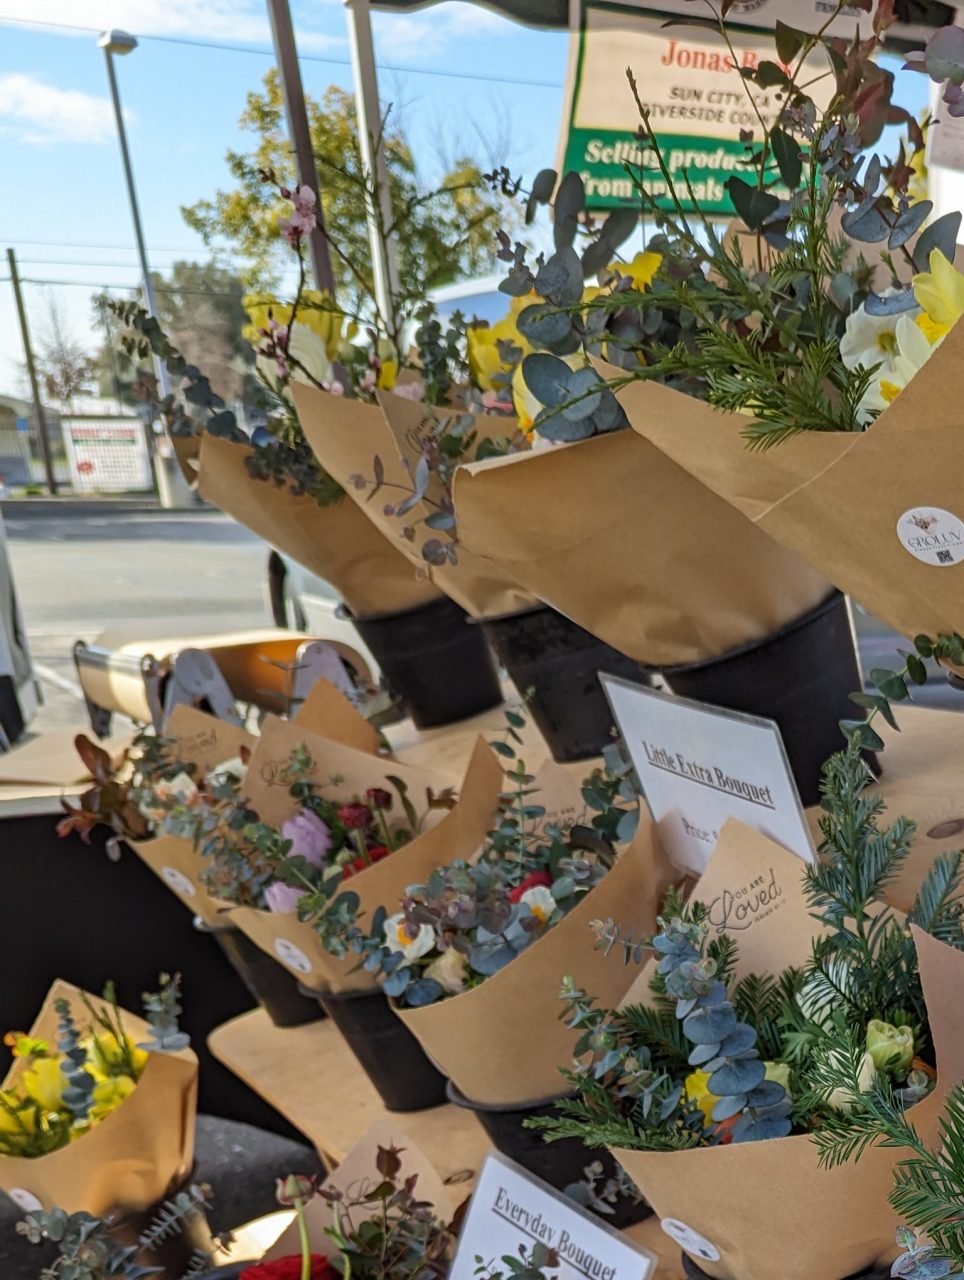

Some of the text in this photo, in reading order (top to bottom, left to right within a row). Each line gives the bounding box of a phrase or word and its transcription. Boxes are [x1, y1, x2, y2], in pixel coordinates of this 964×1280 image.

[661, 40, 733, 73] Jonas
[669, 86, 704, 102] SUN
[642, 741, 774, 805] Little Extra Bouquet
[708, 868, 782, 934] Loved
[494, 1187, 555, 1243] Everyday
